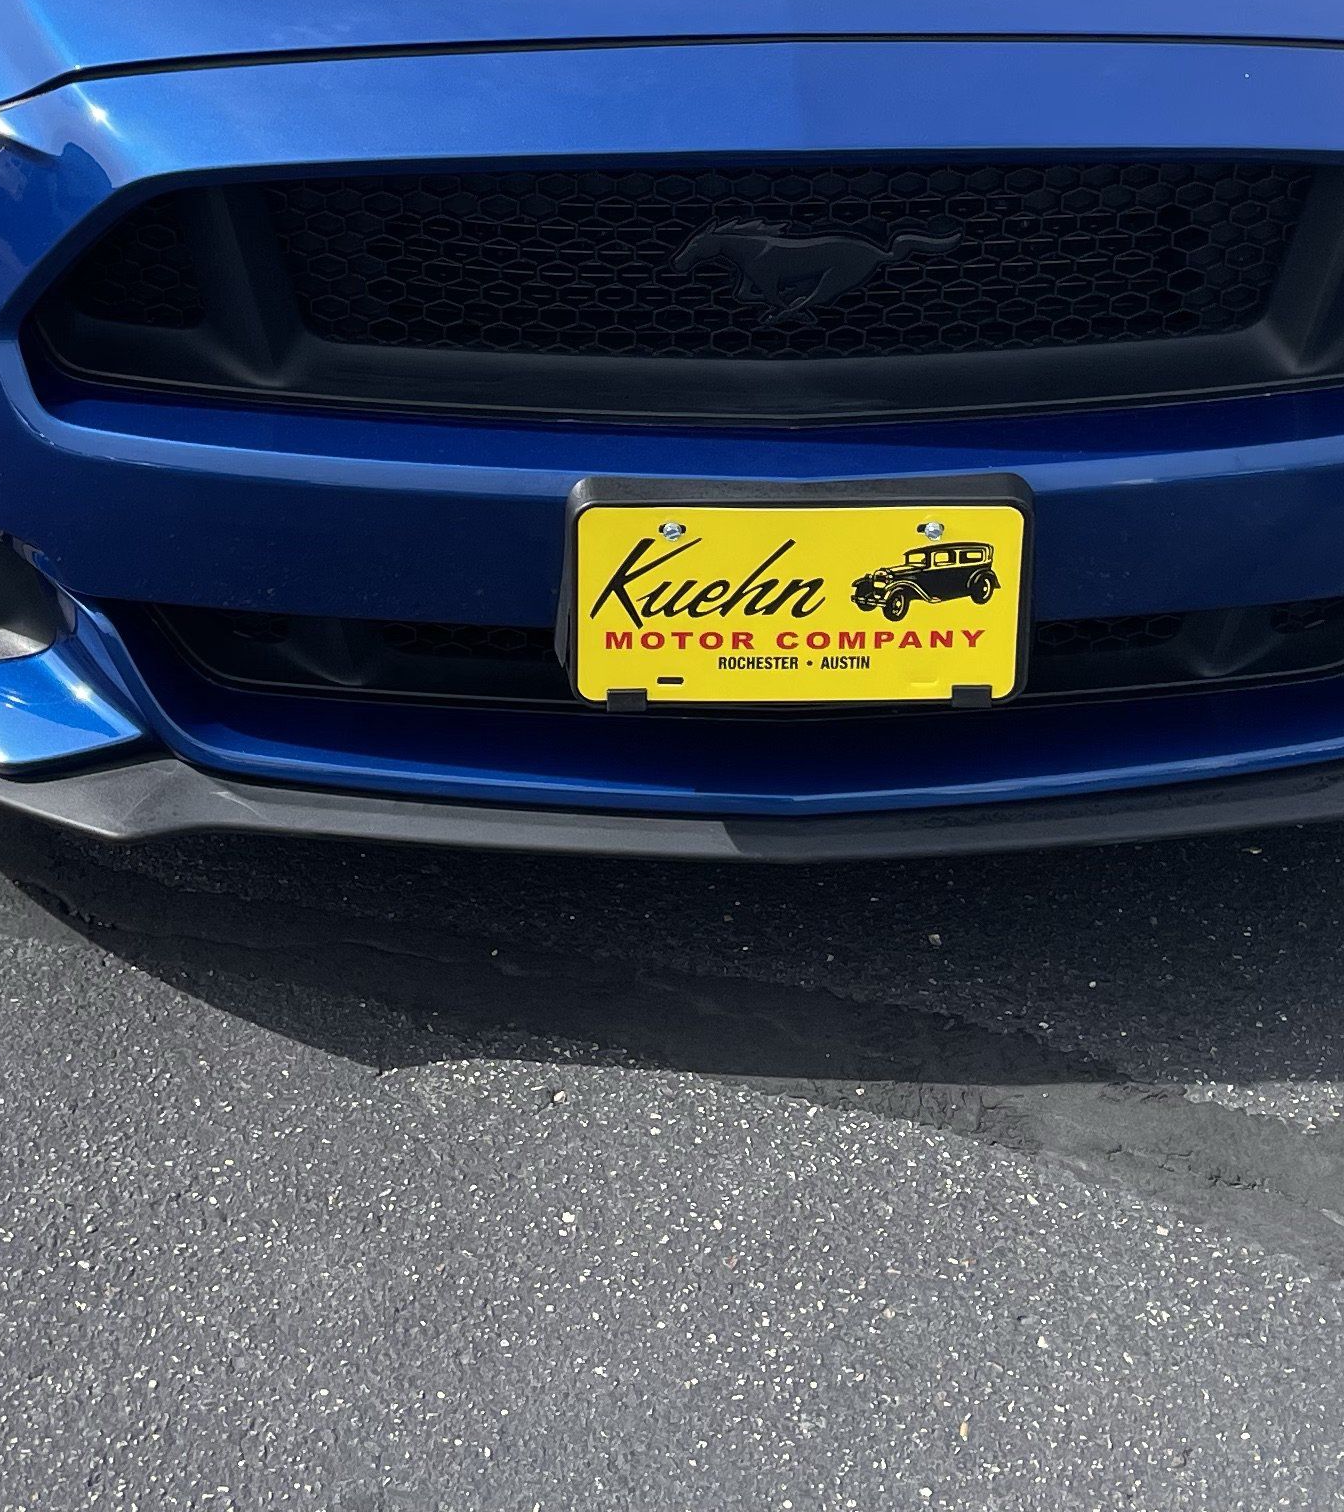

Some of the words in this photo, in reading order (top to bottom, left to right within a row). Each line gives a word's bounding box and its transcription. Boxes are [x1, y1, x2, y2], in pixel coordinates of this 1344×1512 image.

[590, 537, 825, 629] Kuehn
[605, 631, 755, 650] MOTOR
[776, 629, 986, 650] COMPANY
[718, 656, 798, 670] ROCHESTER
[820, 655, 870, 669] AUSTIN
